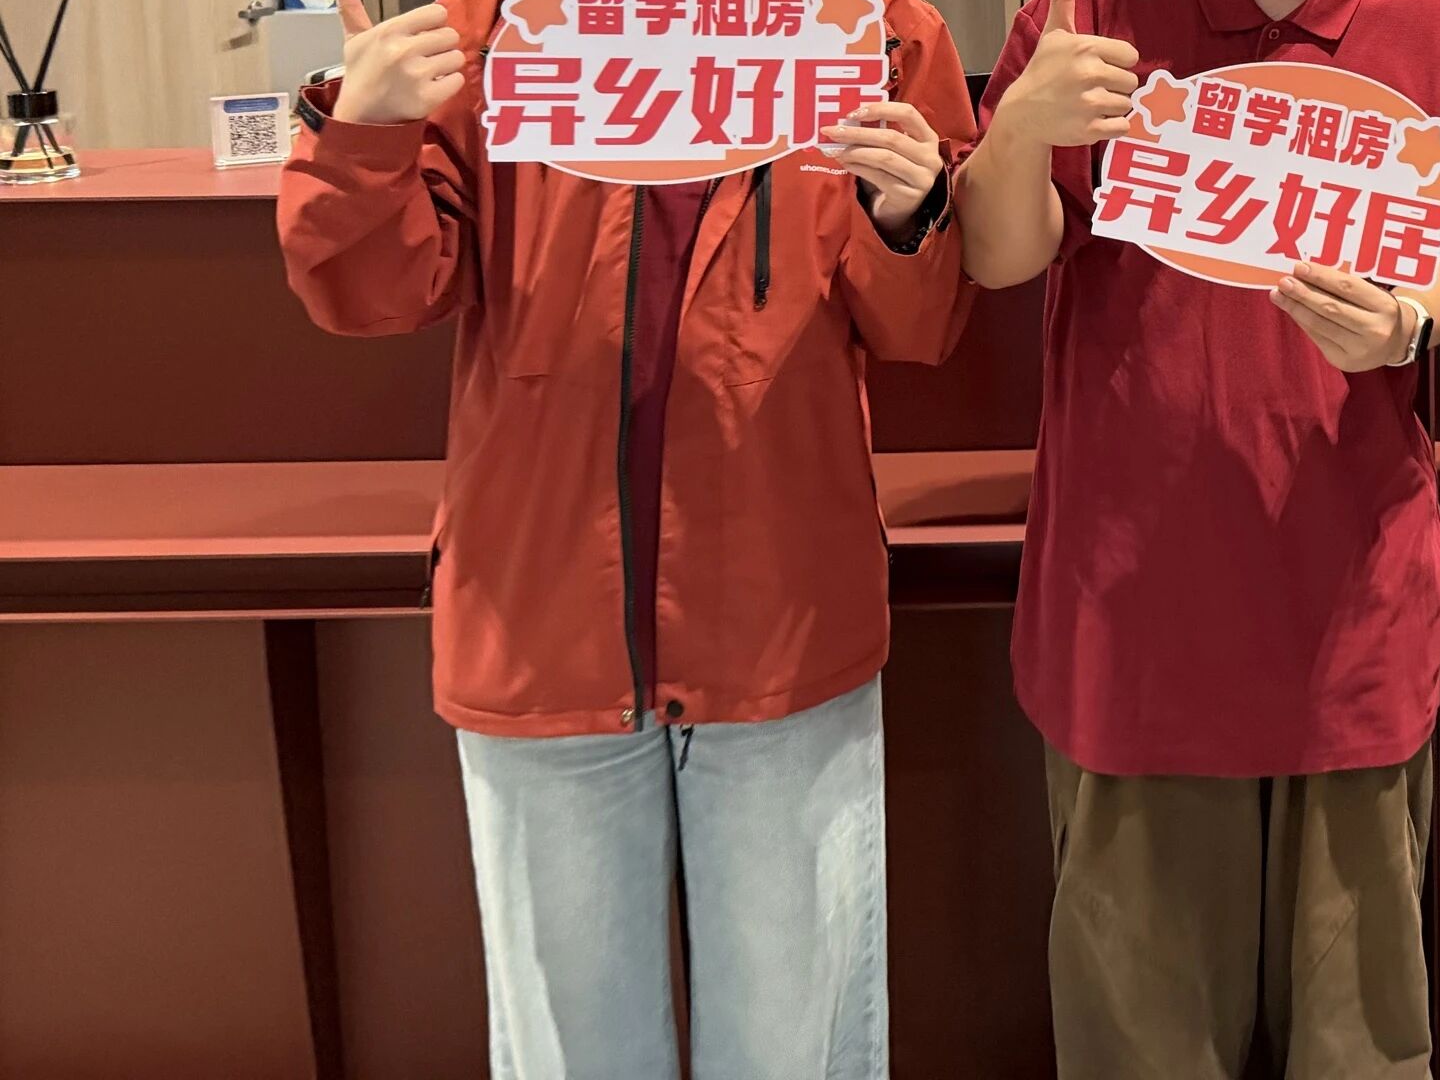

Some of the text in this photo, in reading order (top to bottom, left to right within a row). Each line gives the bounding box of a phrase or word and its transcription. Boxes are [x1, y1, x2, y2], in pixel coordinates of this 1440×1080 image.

[488, 56, 883, 145] 异乡好居
[1192, 82, 1392, 169] 留学租房
